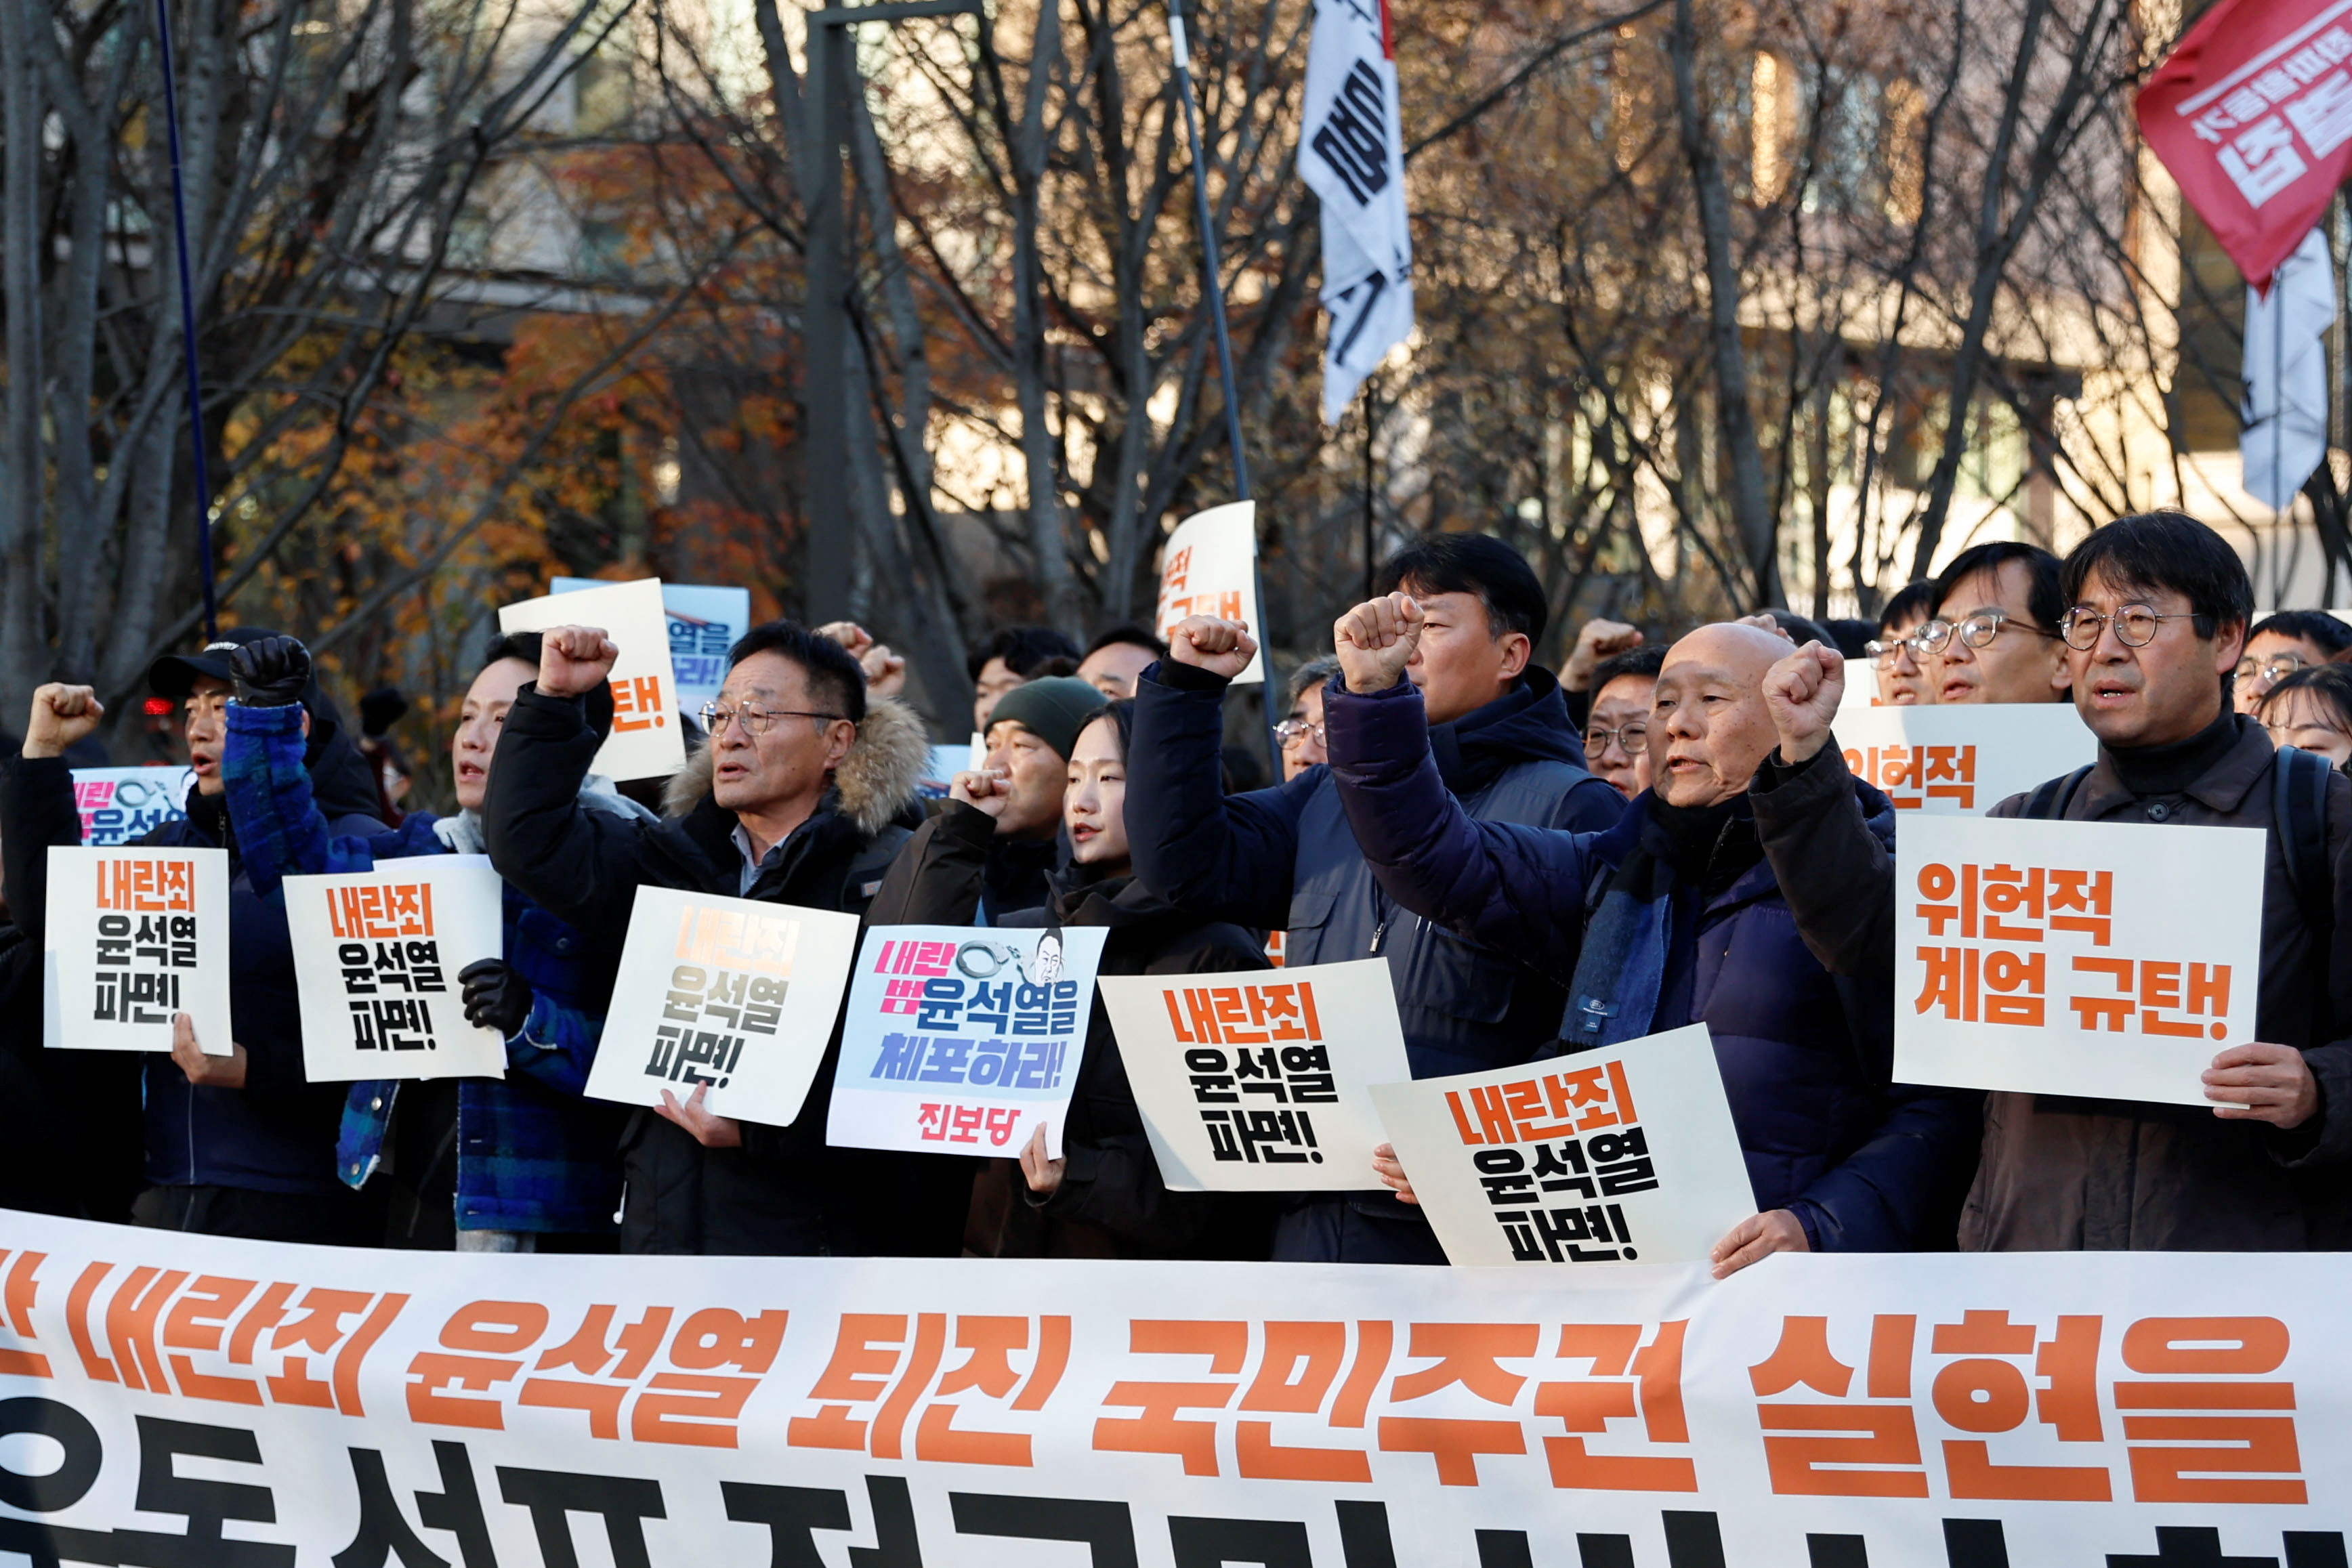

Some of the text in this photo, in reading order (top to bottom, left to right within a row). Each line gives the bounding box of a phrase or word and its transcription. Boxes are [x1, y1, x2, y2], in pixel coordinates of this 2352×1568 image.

[610, 676, 665, 733] 탄!
[97, 860, 195, 912] 내란죄
[327, 883, 434, 938] 내란죄
[1916, 863, 2113, 946] 위헌적
[96, 915, 196, 968] 윤석열
[338, 941, 446, 994] 윤석열
[675, 905, 801, 975] 내란죄
[873, 940, 957, 977] 내란
[93, 972, 180, 1024] 파면!
[665, 965, 790, 1036] 윤석열
[1162, 981, 1322, 1044] 내란죄
[1915, 946, 2231, 1040] 계엄 규탄!
[349, 999, 437, 1051] 파면!
[644, 1025, 744, 1090] 파면!
[870, 1032, 1068, 1090] 체포하라!
[1184, 1044, 1339, 1104] 윤석열
[918, 1103, 1021, 1146] 진보당
[1445, 1060, 1638, 1146] 내란죄
[1200, 1109, 1323, 1164] 파면!
[1473, 1126, 1660, 1205] 윤석열
[1494, 1204, 1638, 1263] 파면!
[66, 1261, 411, 1417] 내란죄
[406, 1298, 789, 1449] 윤석열
[787, 1313, 1072, 1468] 퇴진
[1092, 1319, 1698, 1493] 국민주권
[1748, 1309, 2309, 1505] 실현을
